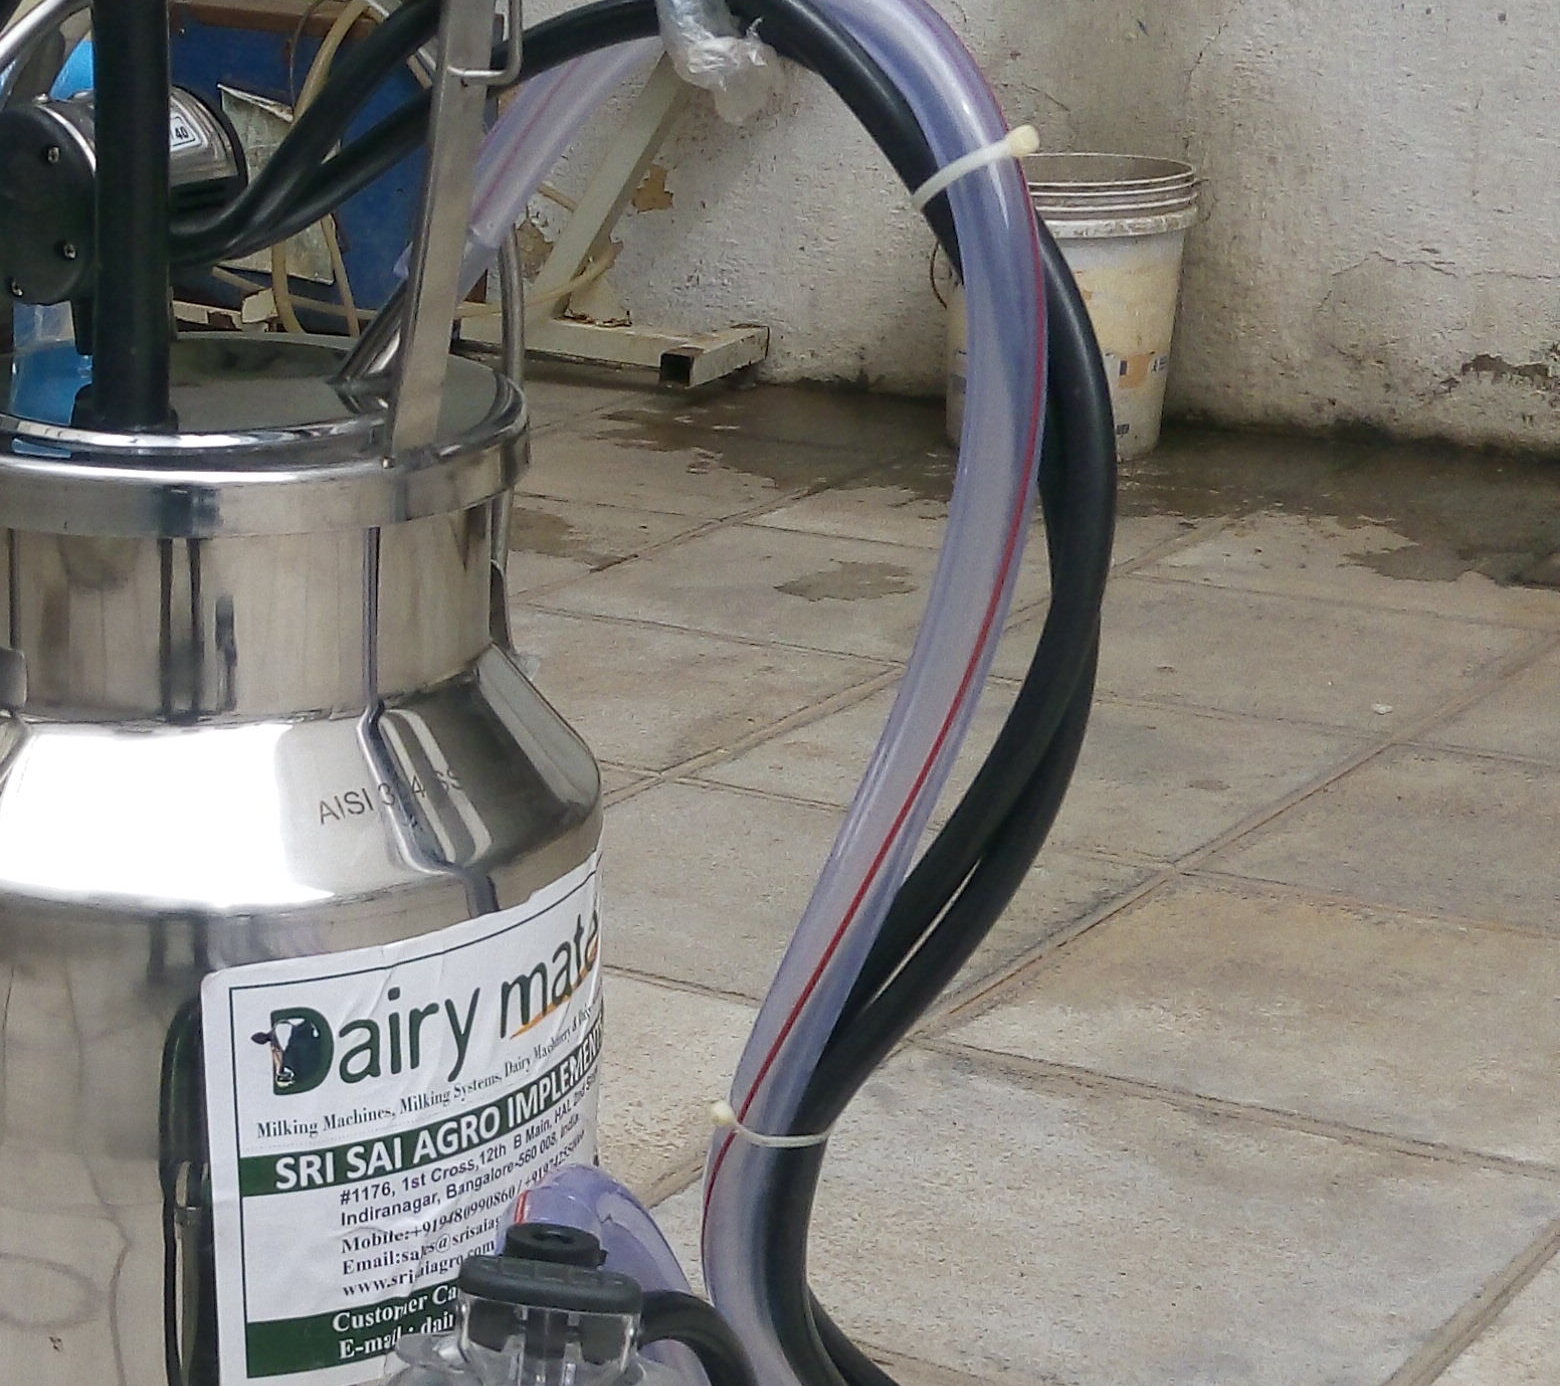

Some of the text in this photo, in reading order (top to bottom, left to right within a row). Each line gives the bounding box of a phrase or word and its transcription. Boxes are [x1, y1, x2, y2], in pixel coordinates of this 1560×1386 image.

[175, 126, 189, 140] 40
[319, 787, 375, 825] AISI
[378, 775, 426, 807] 34
[270, 910, 599, 1095] Dairy mate
[256, 1118, 319, 1139] Milking
[323, 1107, 397, 1131] Machines,
[400, 1090, 451, 1114] Milking
[505, 1056, 531, 1077] Dairy
[275, 1151, 335, 1190] SRI
[347, 1137, 402, 1179] SAI
[412, 1106, 501, 1164] AGRO
[340, 1181, 396, 1206] #1176,
[402, 1172, 426, 1192] 1st
[513, 1133, 522, 1150] B
[341, 1192, 442, 1226] Indiranagar,
[332, 1284, 457, 1333] Customer Ca
